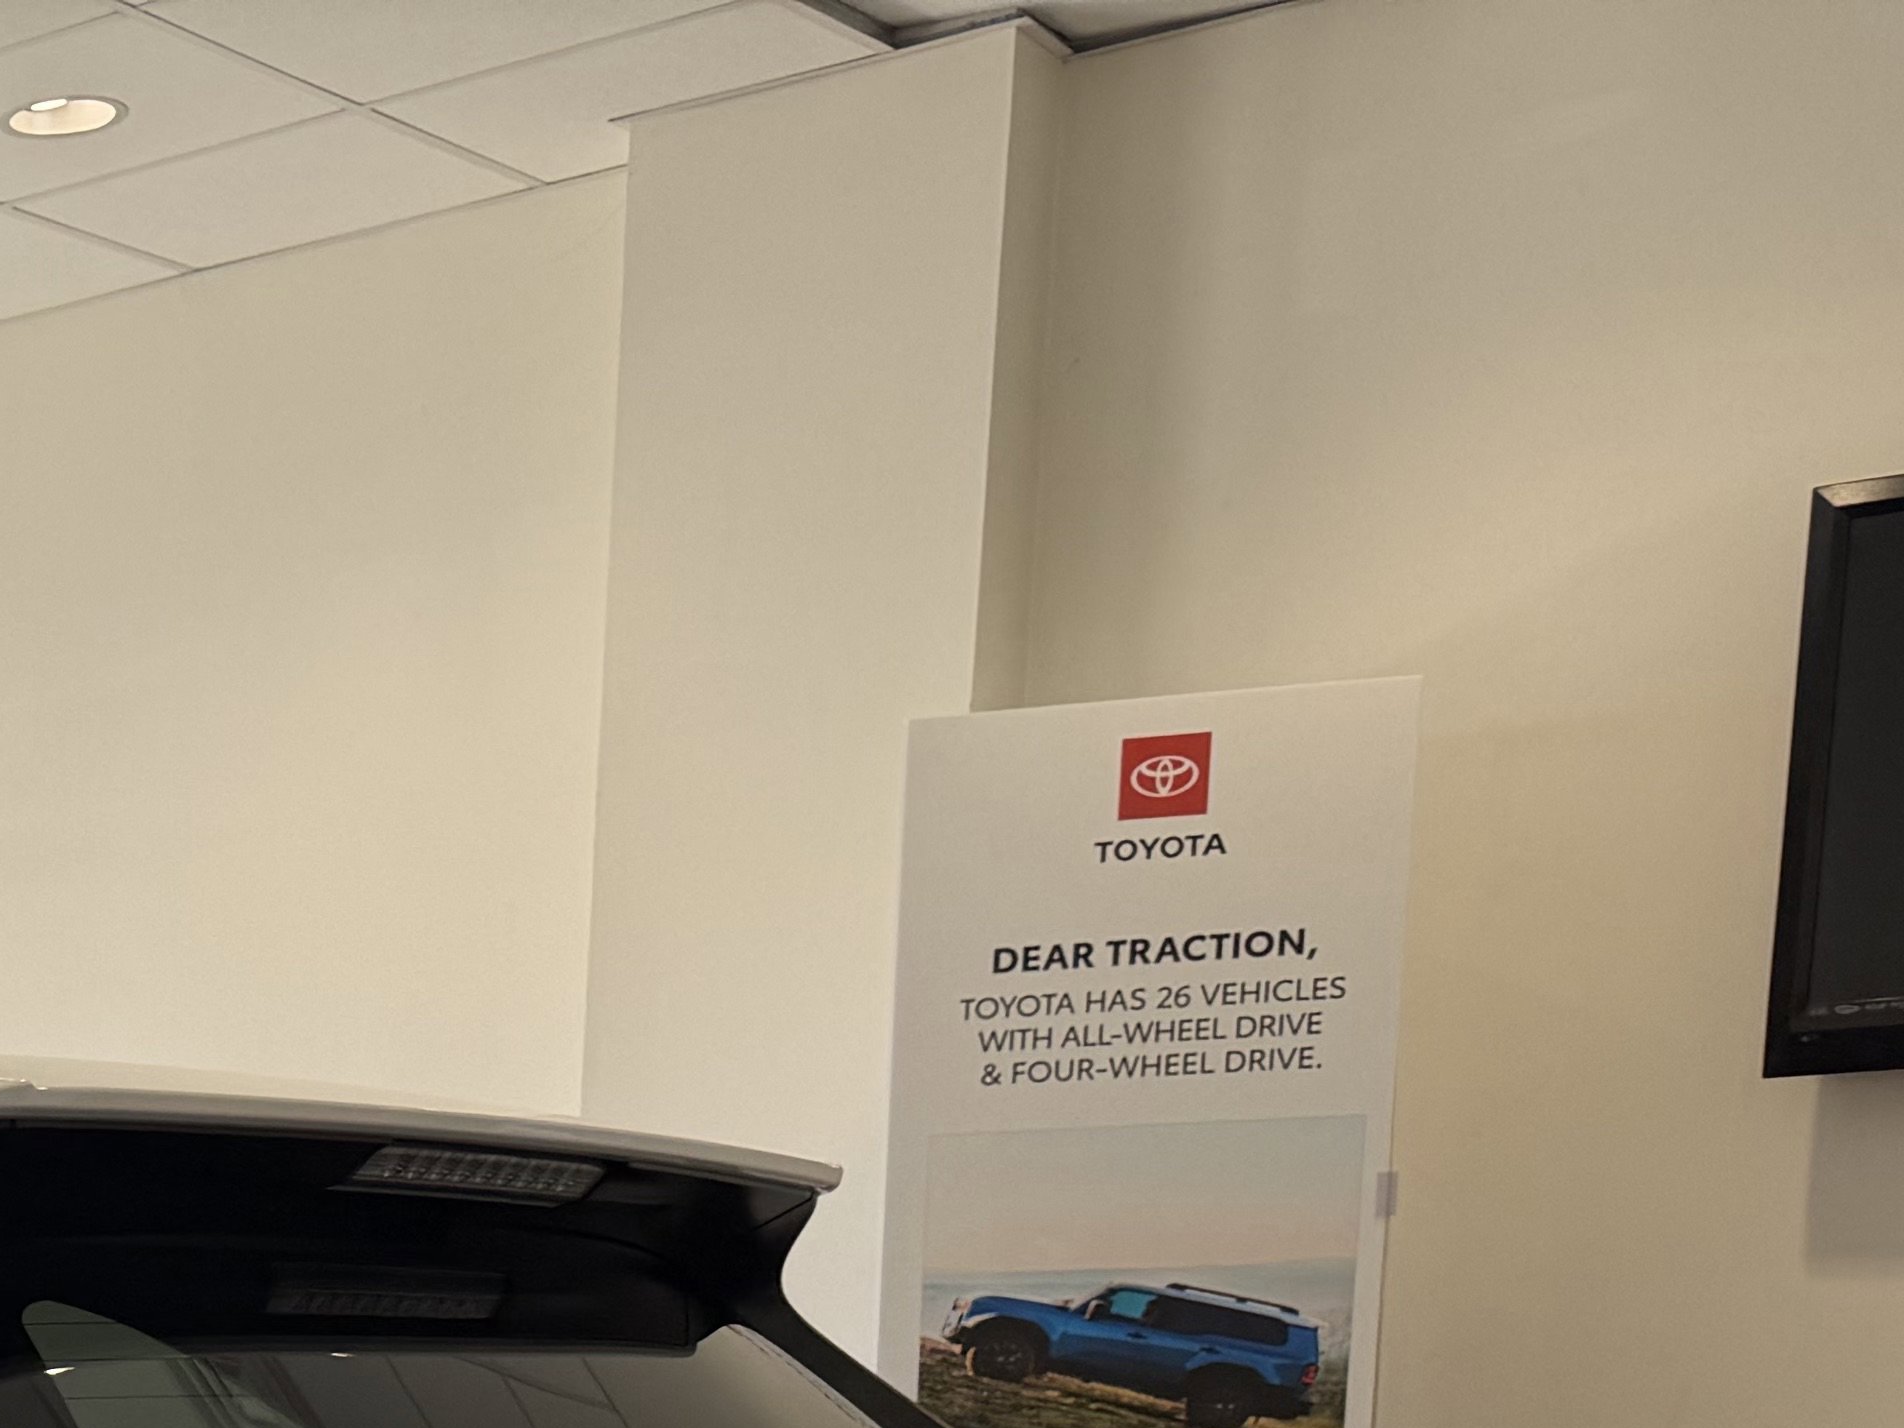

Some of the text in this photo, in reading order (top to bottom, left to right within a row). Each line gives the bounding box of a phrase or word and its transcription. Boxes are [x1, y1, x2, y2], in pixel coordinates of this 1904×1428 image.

[1094, 833, 1227, 863] TOYOTA
[992, 929, 1318, 974] DEAR TRACTION,
[960, 976, 1347, 1022] TOYOTA HAS 26 VEHICLES
[978, 1012, 1324, 1054] WITH ALL-WHEEL DRIVE
[980, 1046, 1323, 1087] & FOUR-WHEEL DRIVE.
